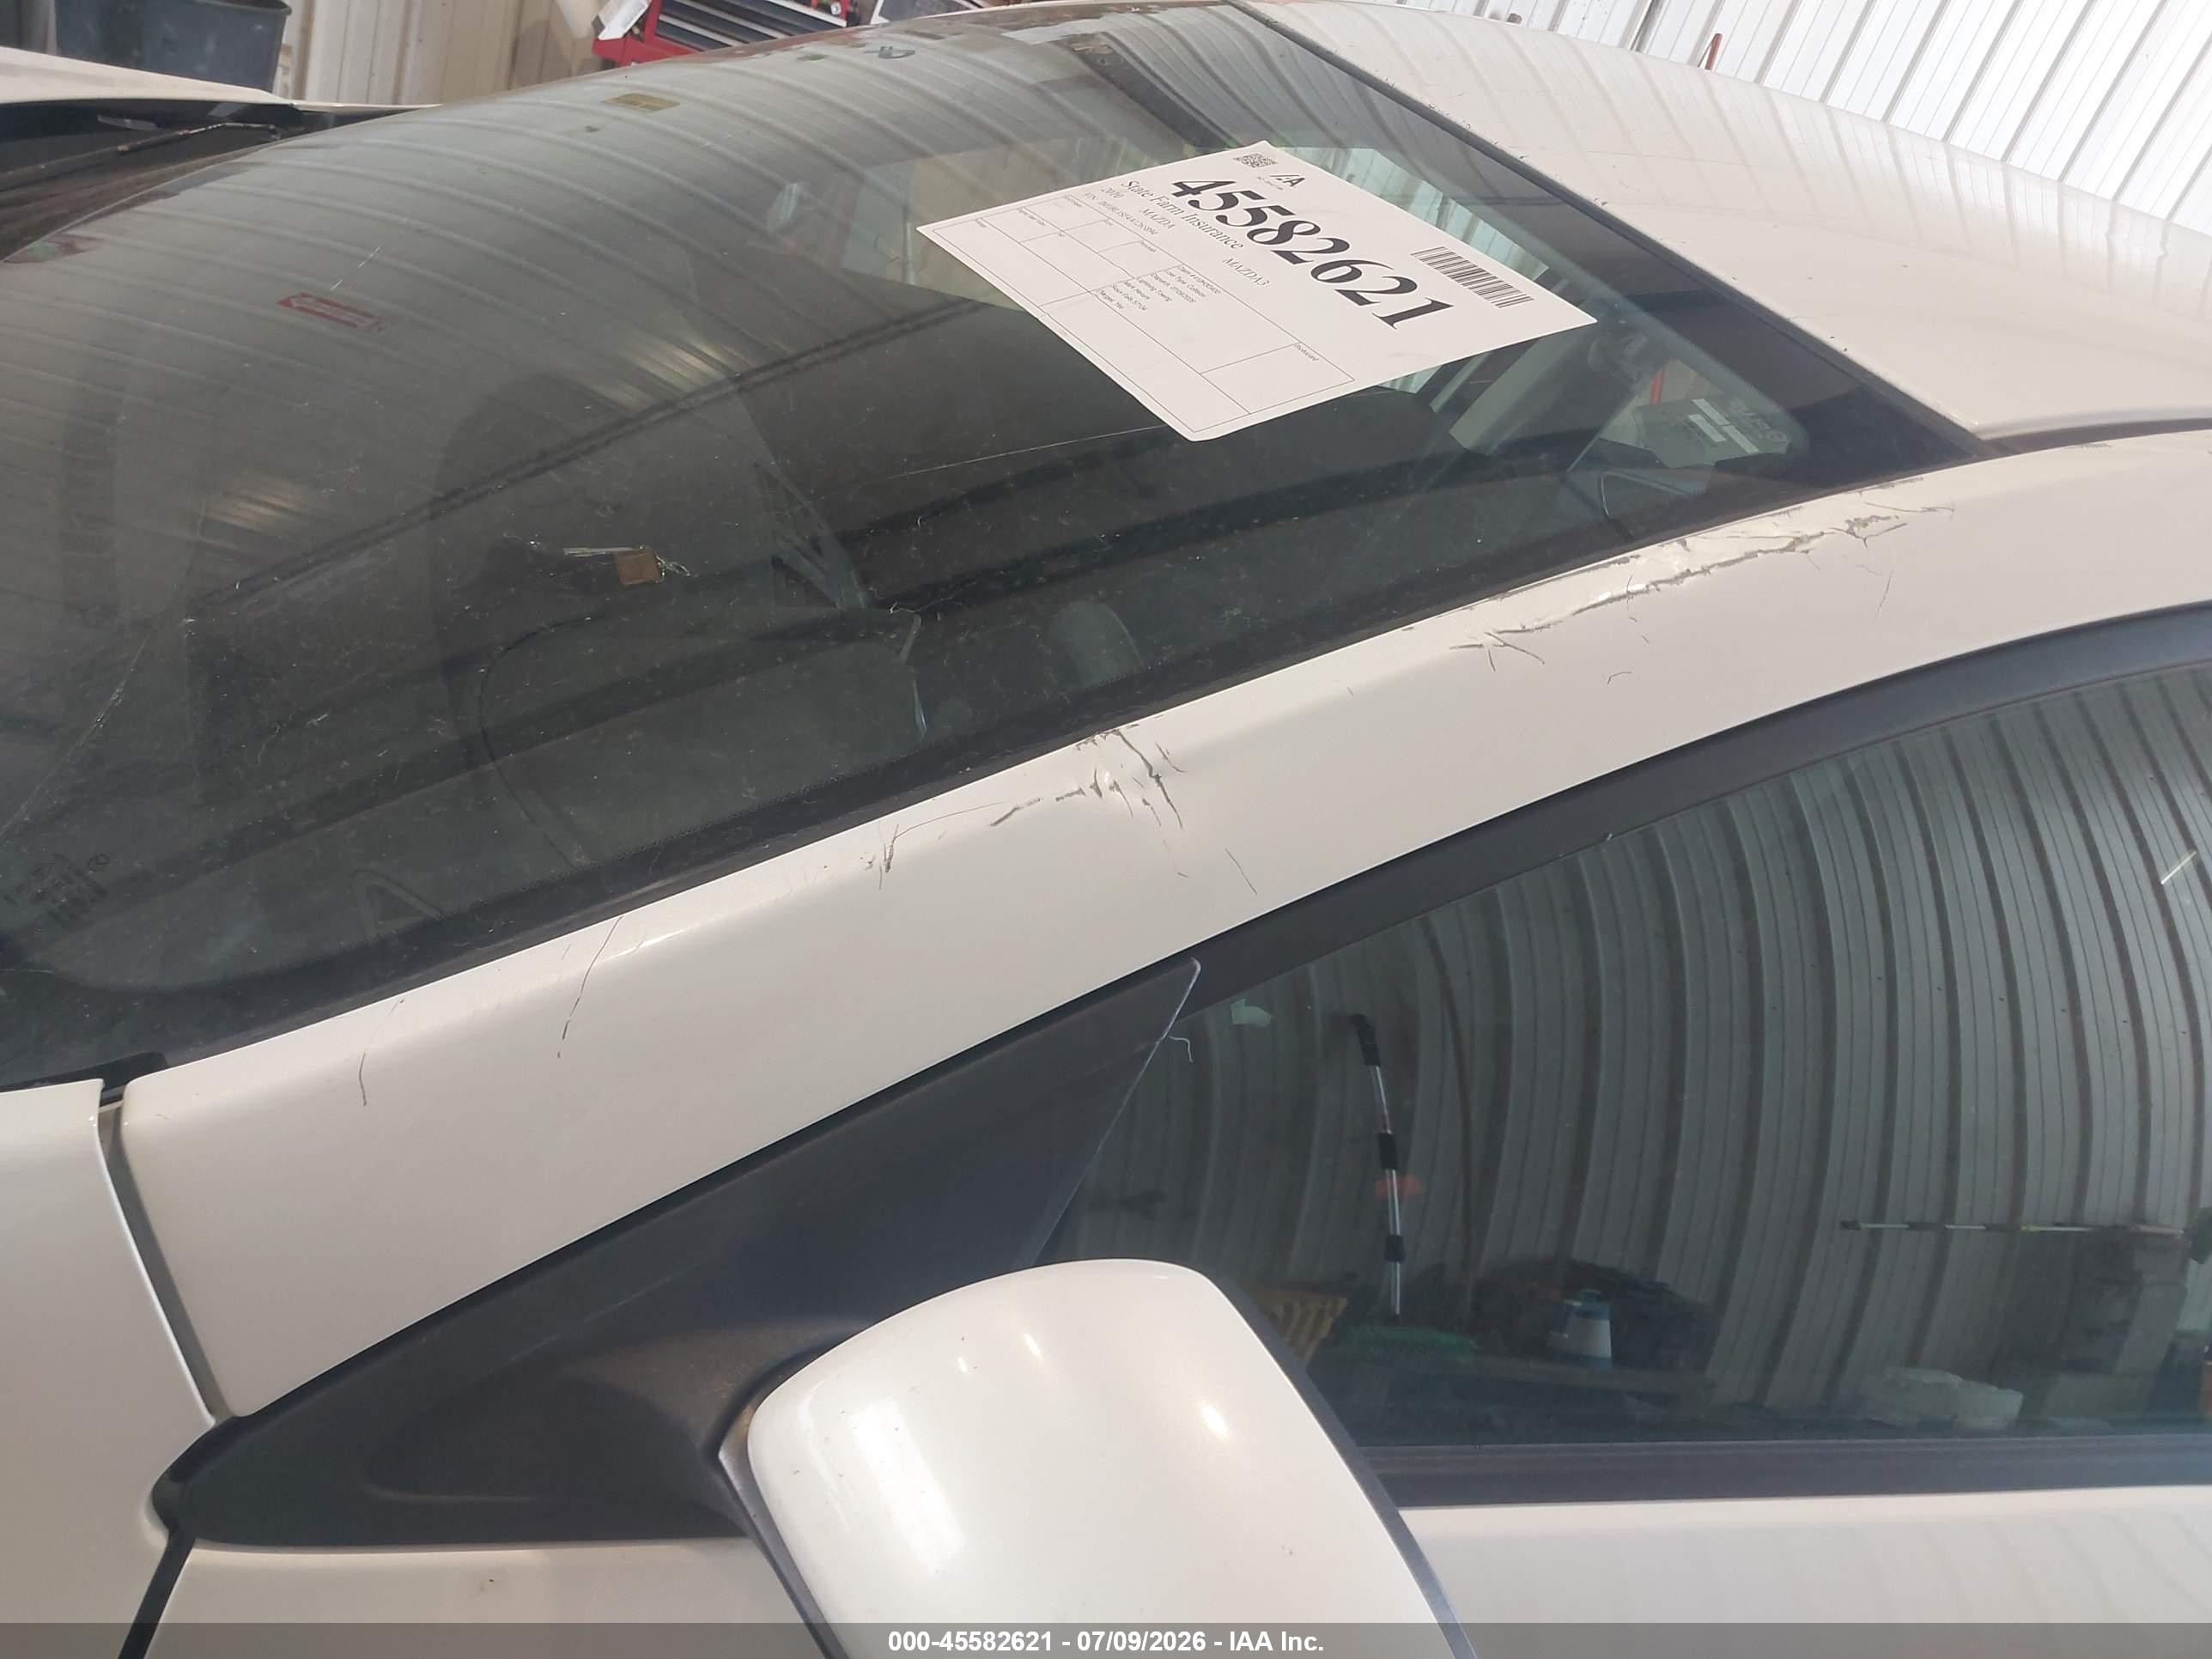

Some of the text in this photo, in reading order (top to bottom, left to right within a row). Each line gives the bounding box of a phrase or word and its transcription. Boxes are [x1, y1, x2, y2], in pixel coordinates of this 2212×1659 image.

[1101, 188, 1124, 198] 2010
[1139, 209, 1176, 229] MAZDA
[1223, 258, 1269, 285] MAZDA3
[1121, 181, 1153, 197] State
[1149, 196, 1185, 219] Farm
[1181, 214, 1243, 249] Insurance
[1172, 181, 1454, 329] 45582621
